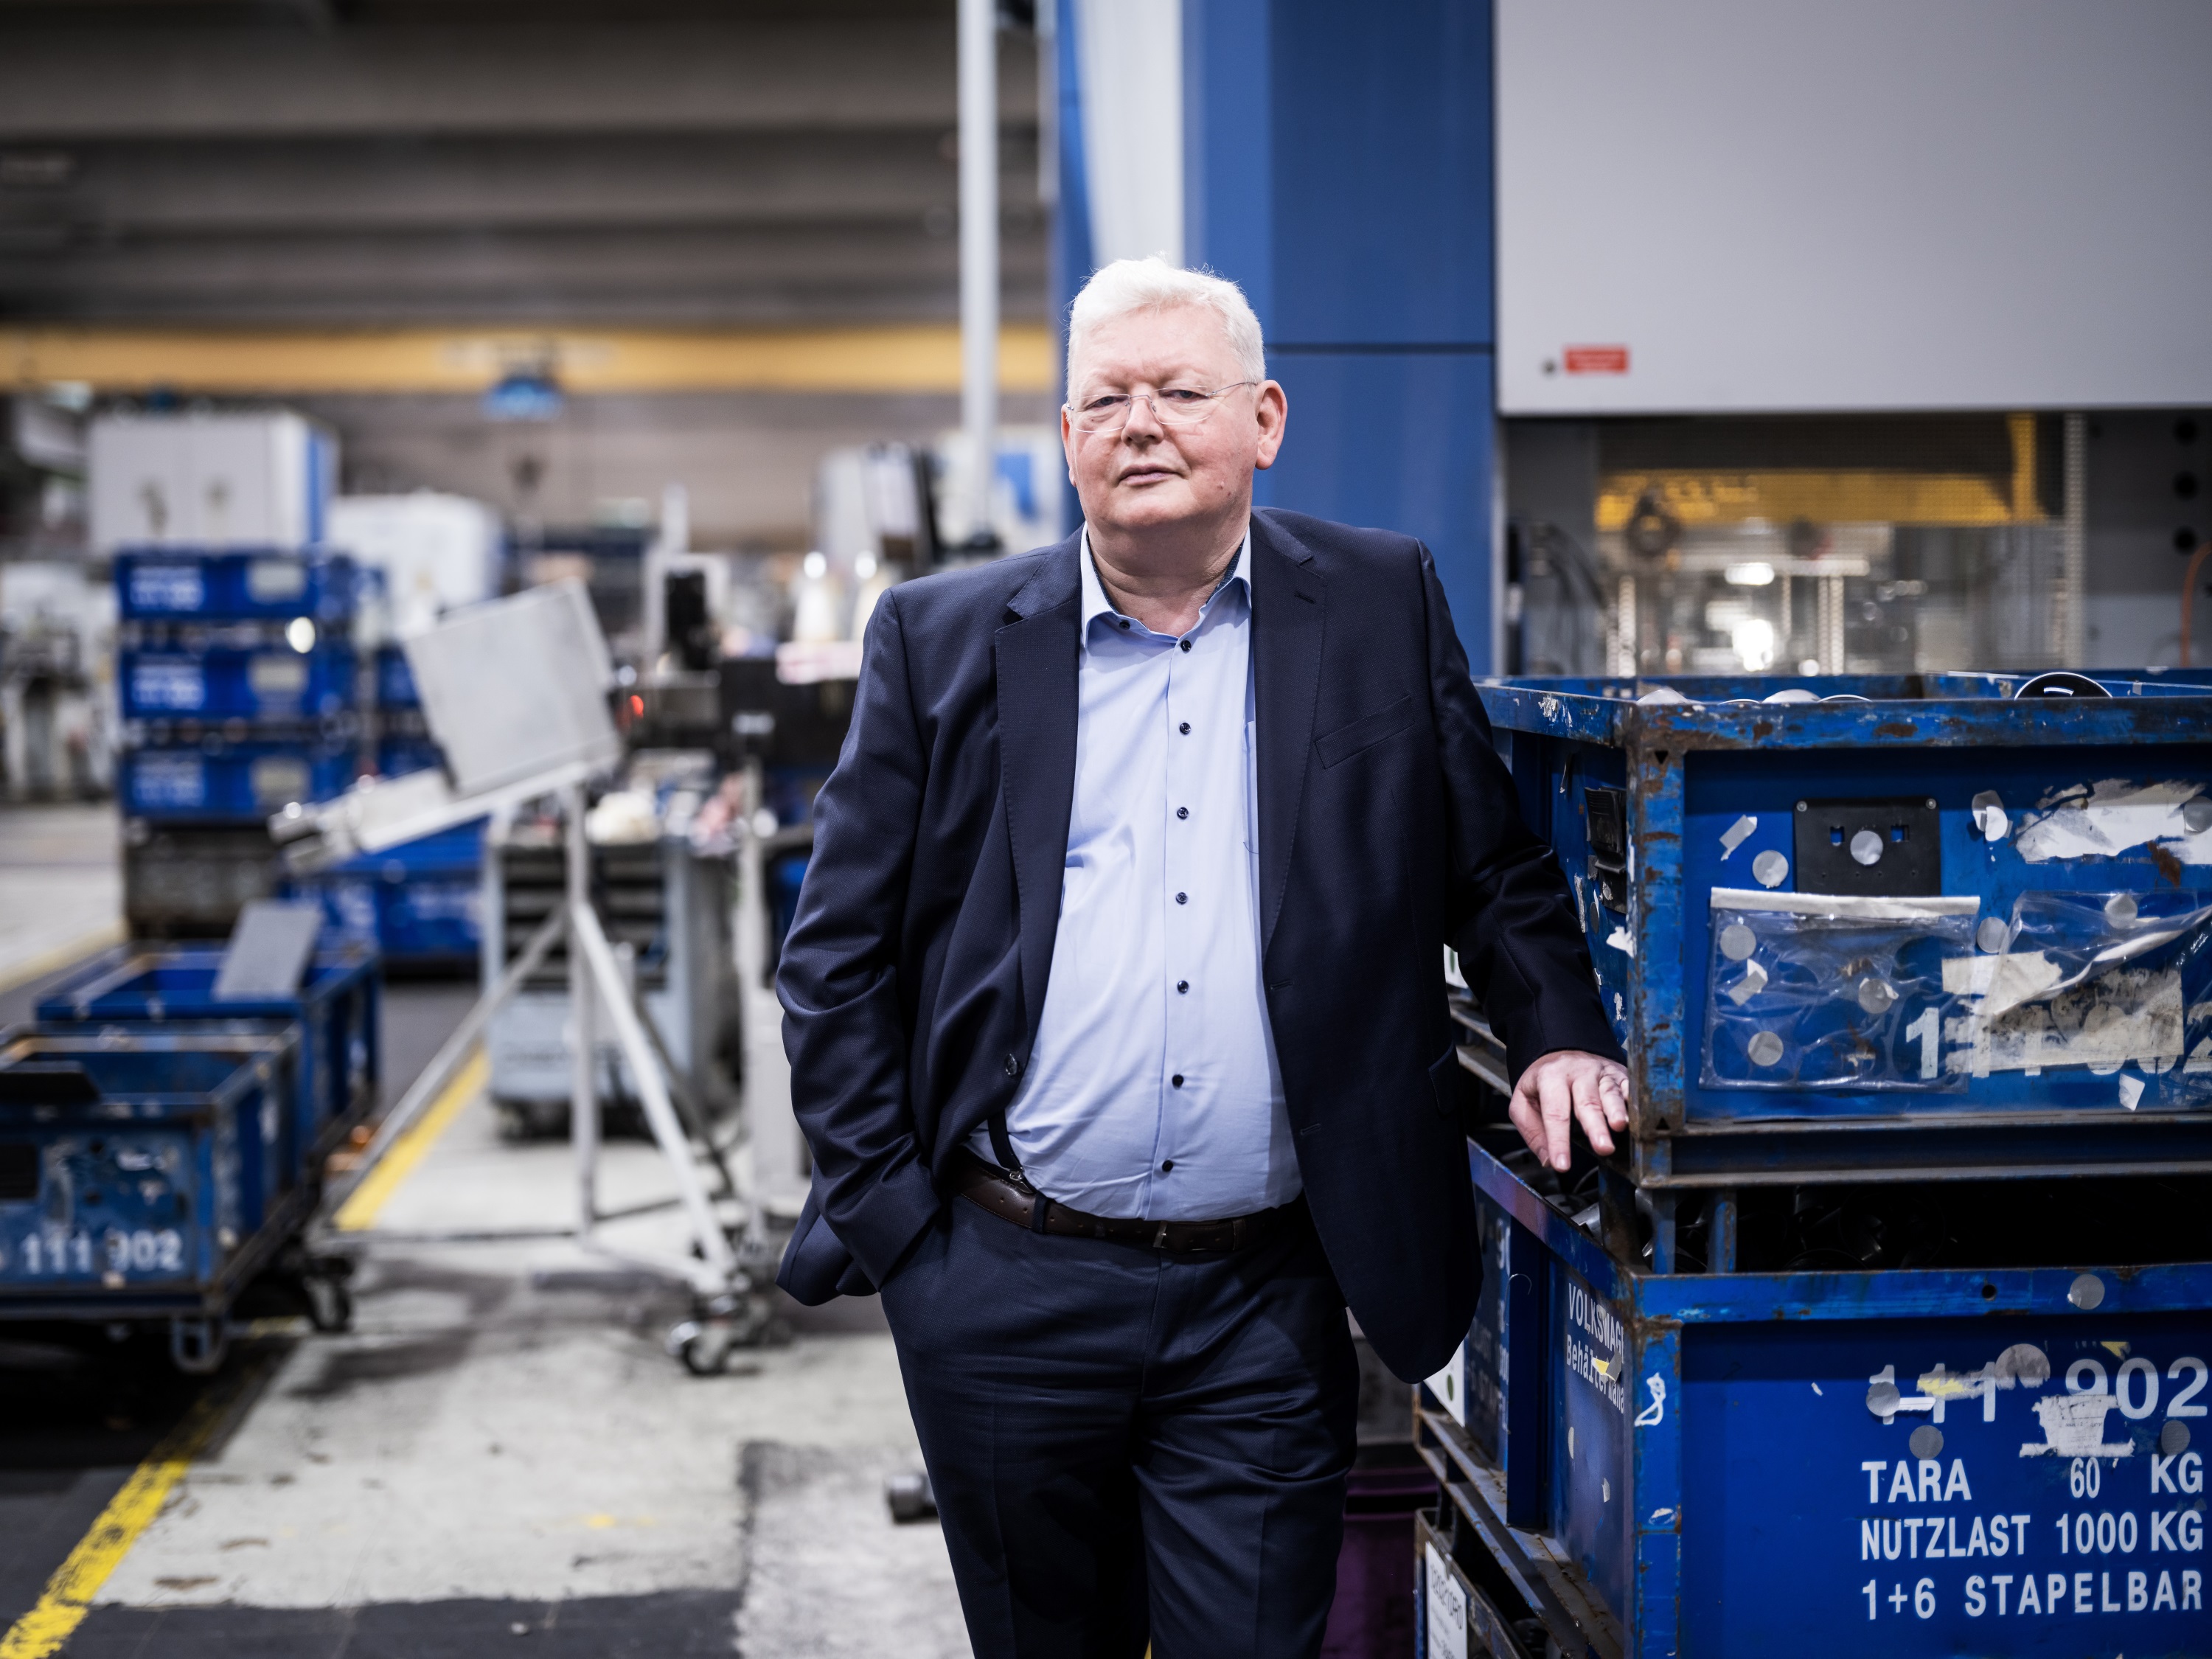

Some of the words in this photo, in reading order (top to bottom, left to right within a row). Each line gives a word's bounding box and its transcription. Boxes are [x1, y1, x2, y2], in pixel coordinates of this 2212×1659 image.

[21, 1231, 92, 1275] 111
[1868, 1361, 1996, 1425] 111
[2065, 1357, 2208, 1419] 902
[1862, 1458, 1972, 1503] TARA
[2070, 1457, 2100, 1498] 60
[2151, 1452, 2203, 1494] KG
[1862, 1514, 2031, 1561] NUTZLAST
[2056, 1512, 2138, 1554] 1000
[2151, 1510, 2203, 1552] KG
[1863, 1577, 1936, 1621] 1+6
[1964, 1570, 2202, 1618] STAPELBAR
